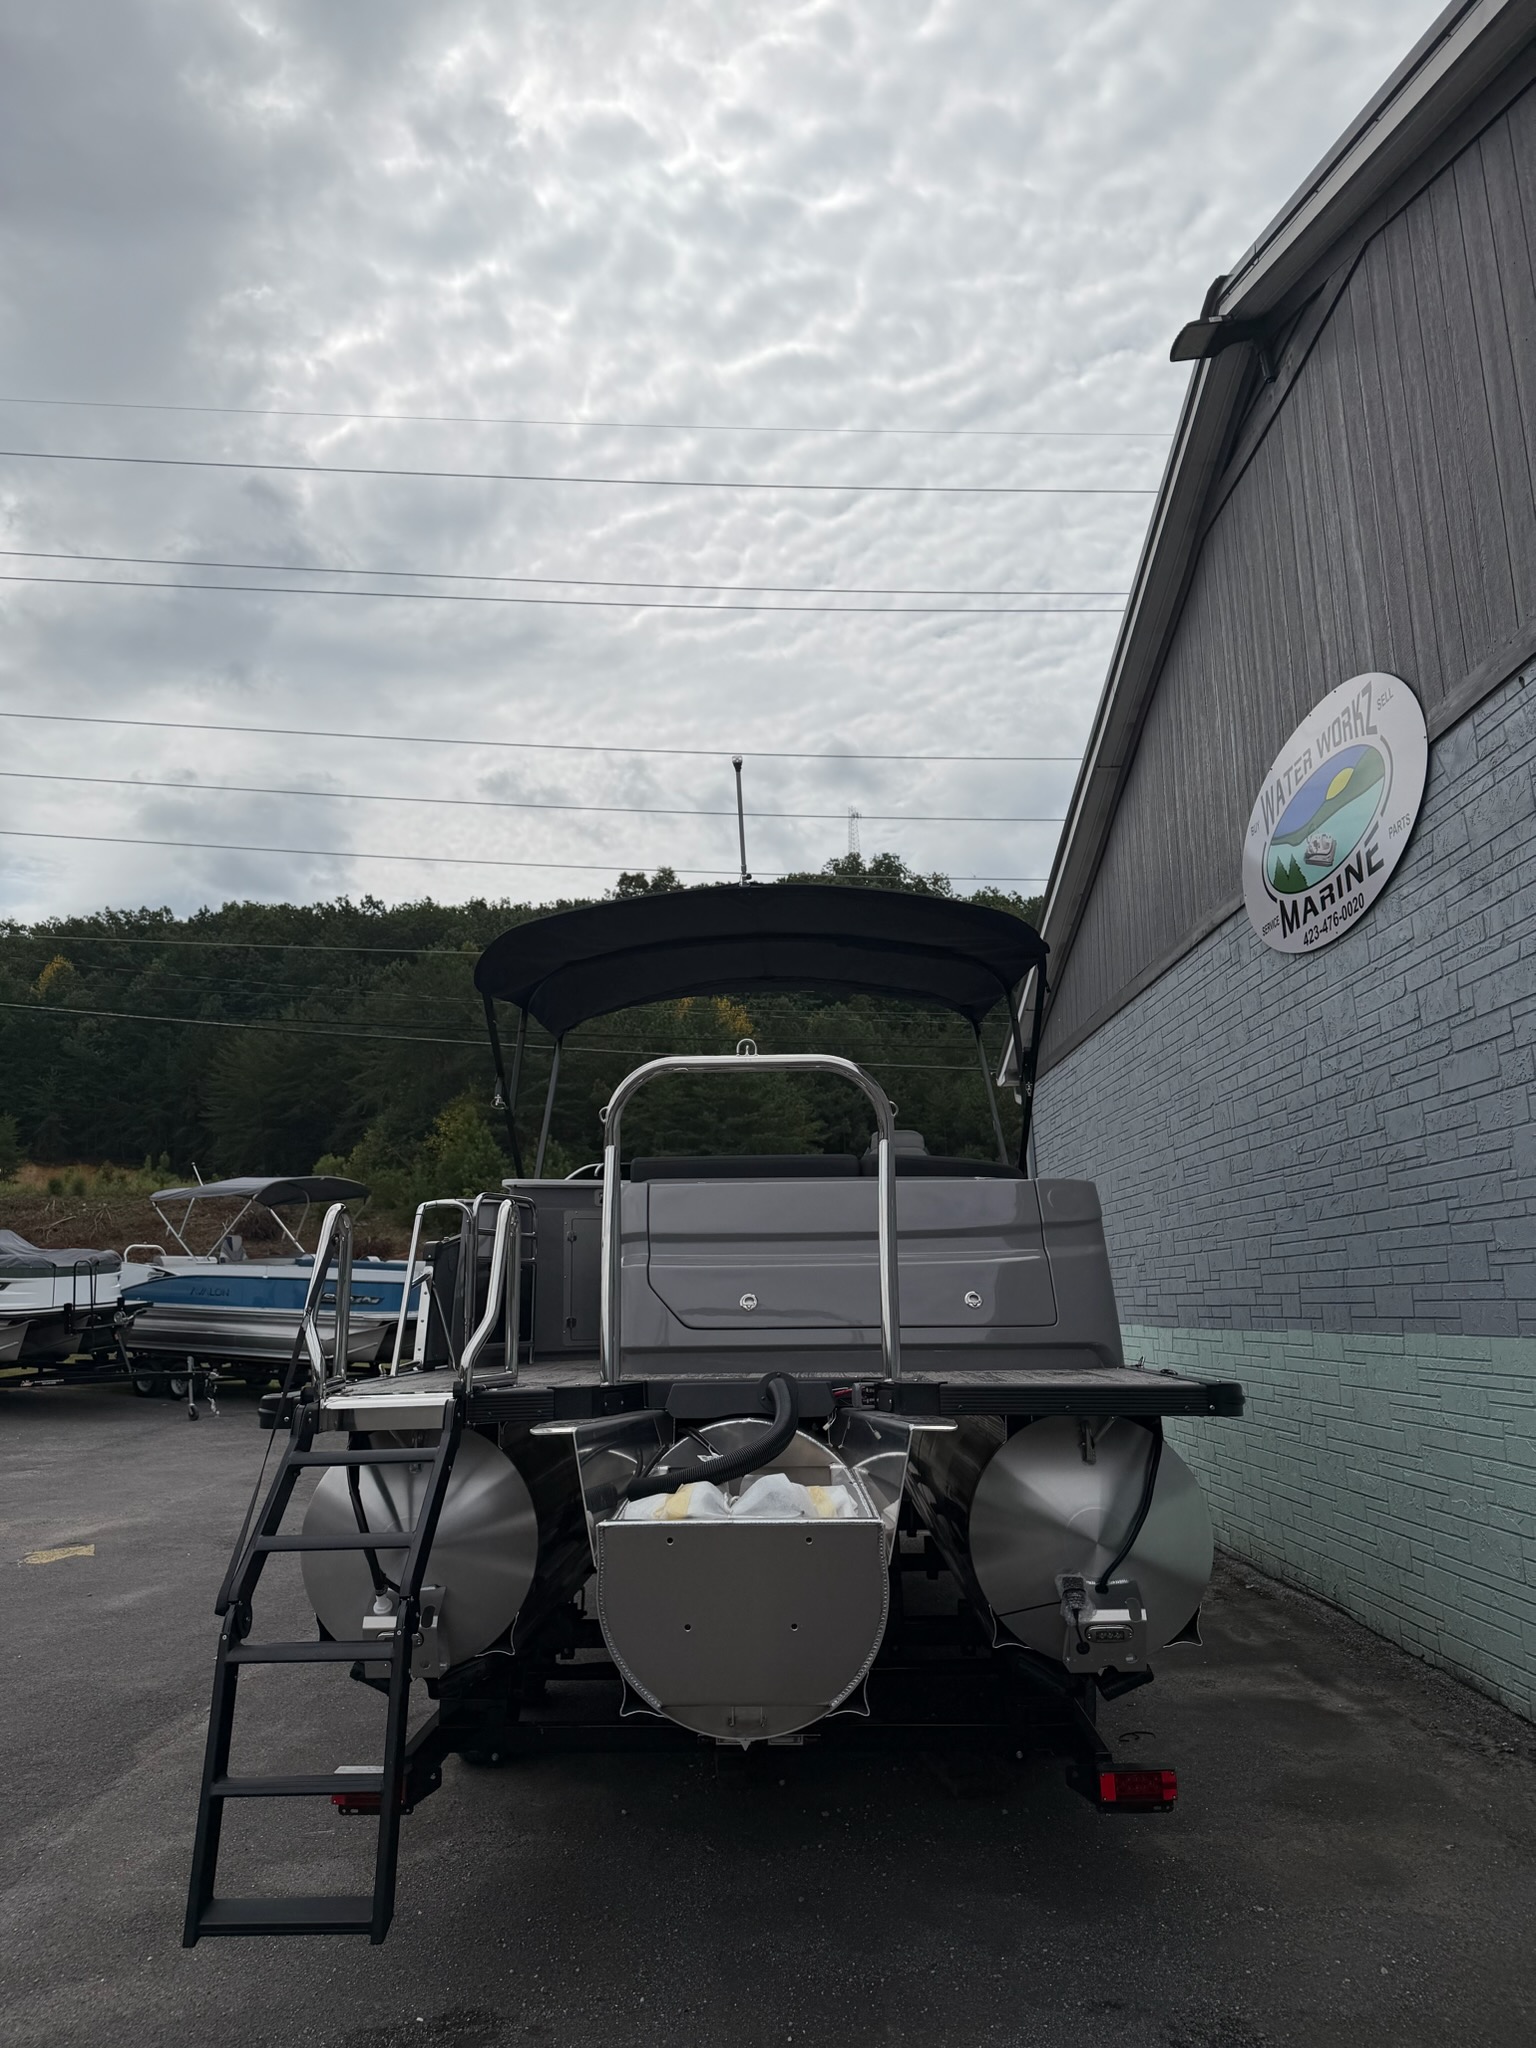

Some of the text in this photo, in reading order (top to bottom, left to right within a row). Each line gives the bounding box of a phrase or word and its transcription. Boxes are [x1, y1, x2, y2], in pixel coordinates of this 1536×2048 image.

[1377, 688, 1394, 711] SELL
[1261, 680, 1378, 836] WATER WORKZ
[1250, 823, 1260, 837] BUY
[1388, 813, 1411, 839] PARTS
[1279, 820, 1385, 939] MARINE
[1261, 915, 1280, 937] SERVICE
[1303, 892, 1365, 947] 423-476-0020
